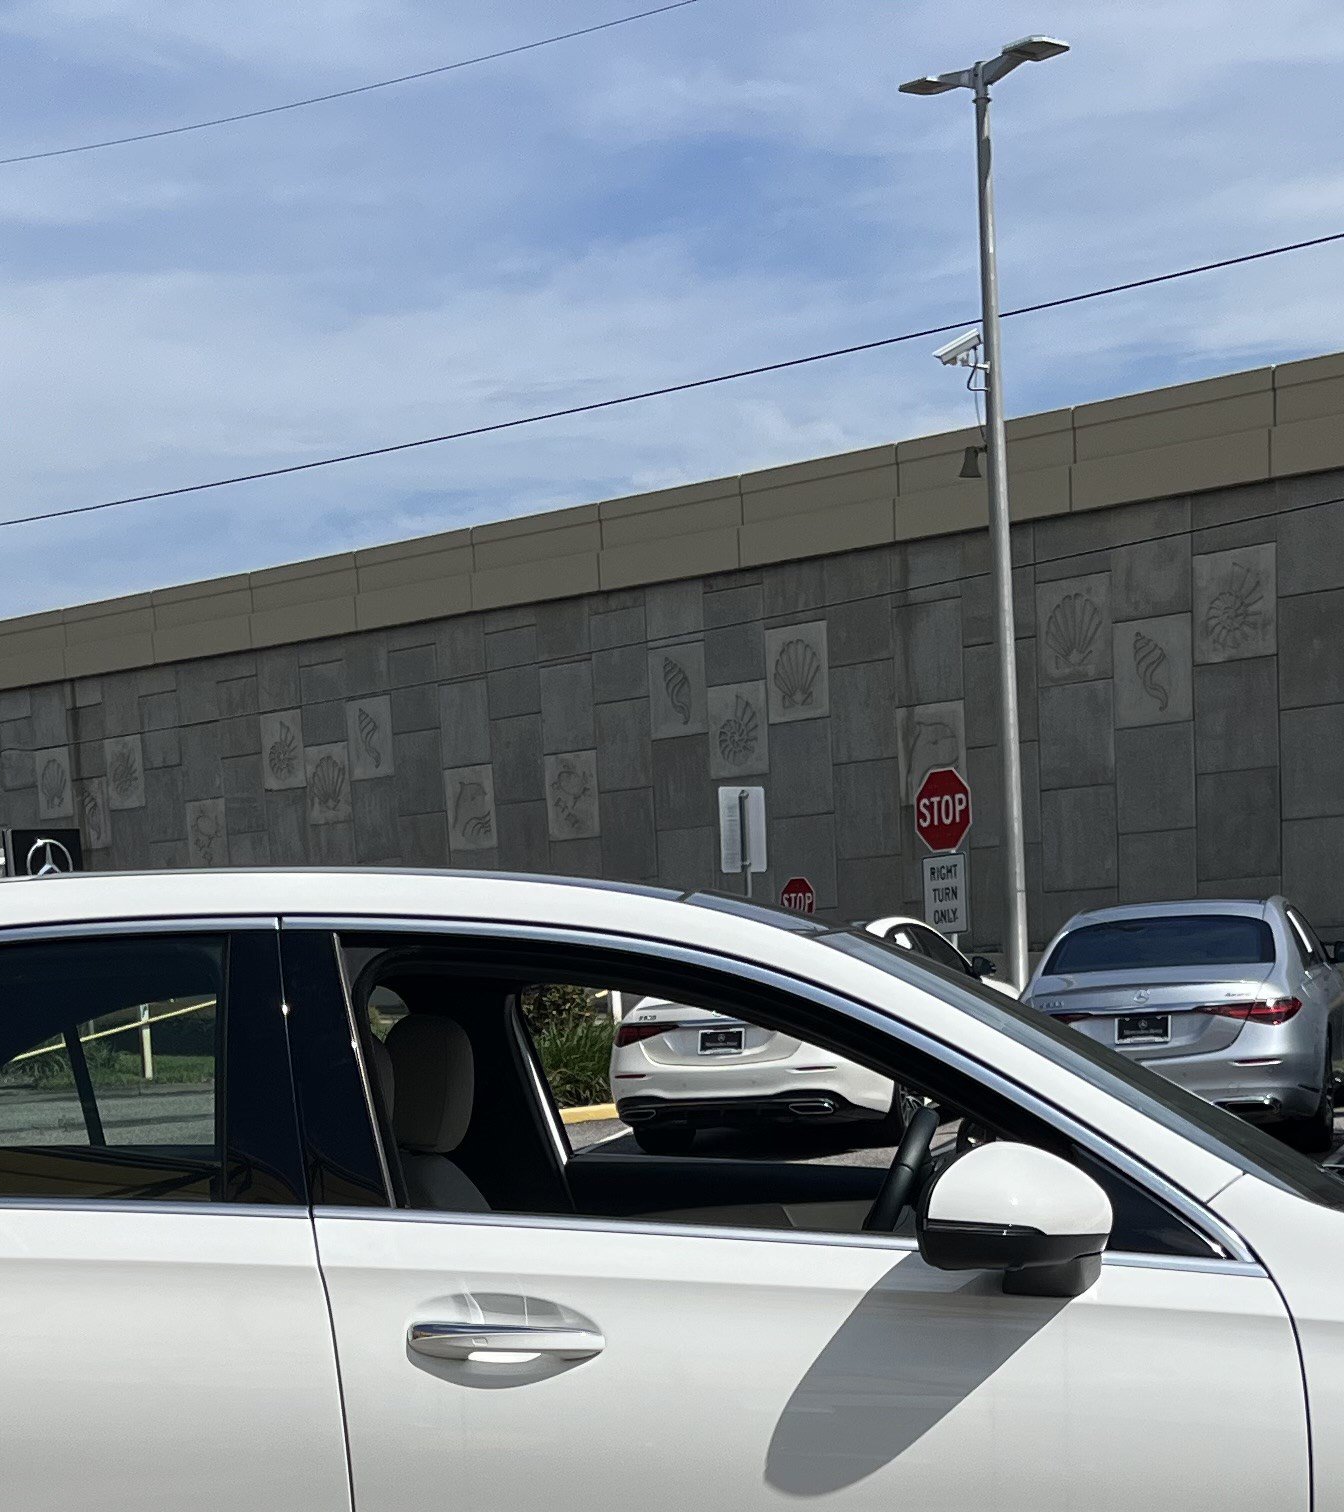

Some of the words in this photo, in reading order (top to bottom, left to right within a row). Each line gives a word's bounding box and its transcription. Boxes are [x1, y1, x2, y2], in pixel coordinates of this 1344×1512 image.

[919, 793, 967, 828] STOP
[929, 864, 958, 881] RIGHT
[782, 892, 813, 912] STOP
[932, 886, 958, 903] TURN
[933, 908, 959, 925] ONLY
